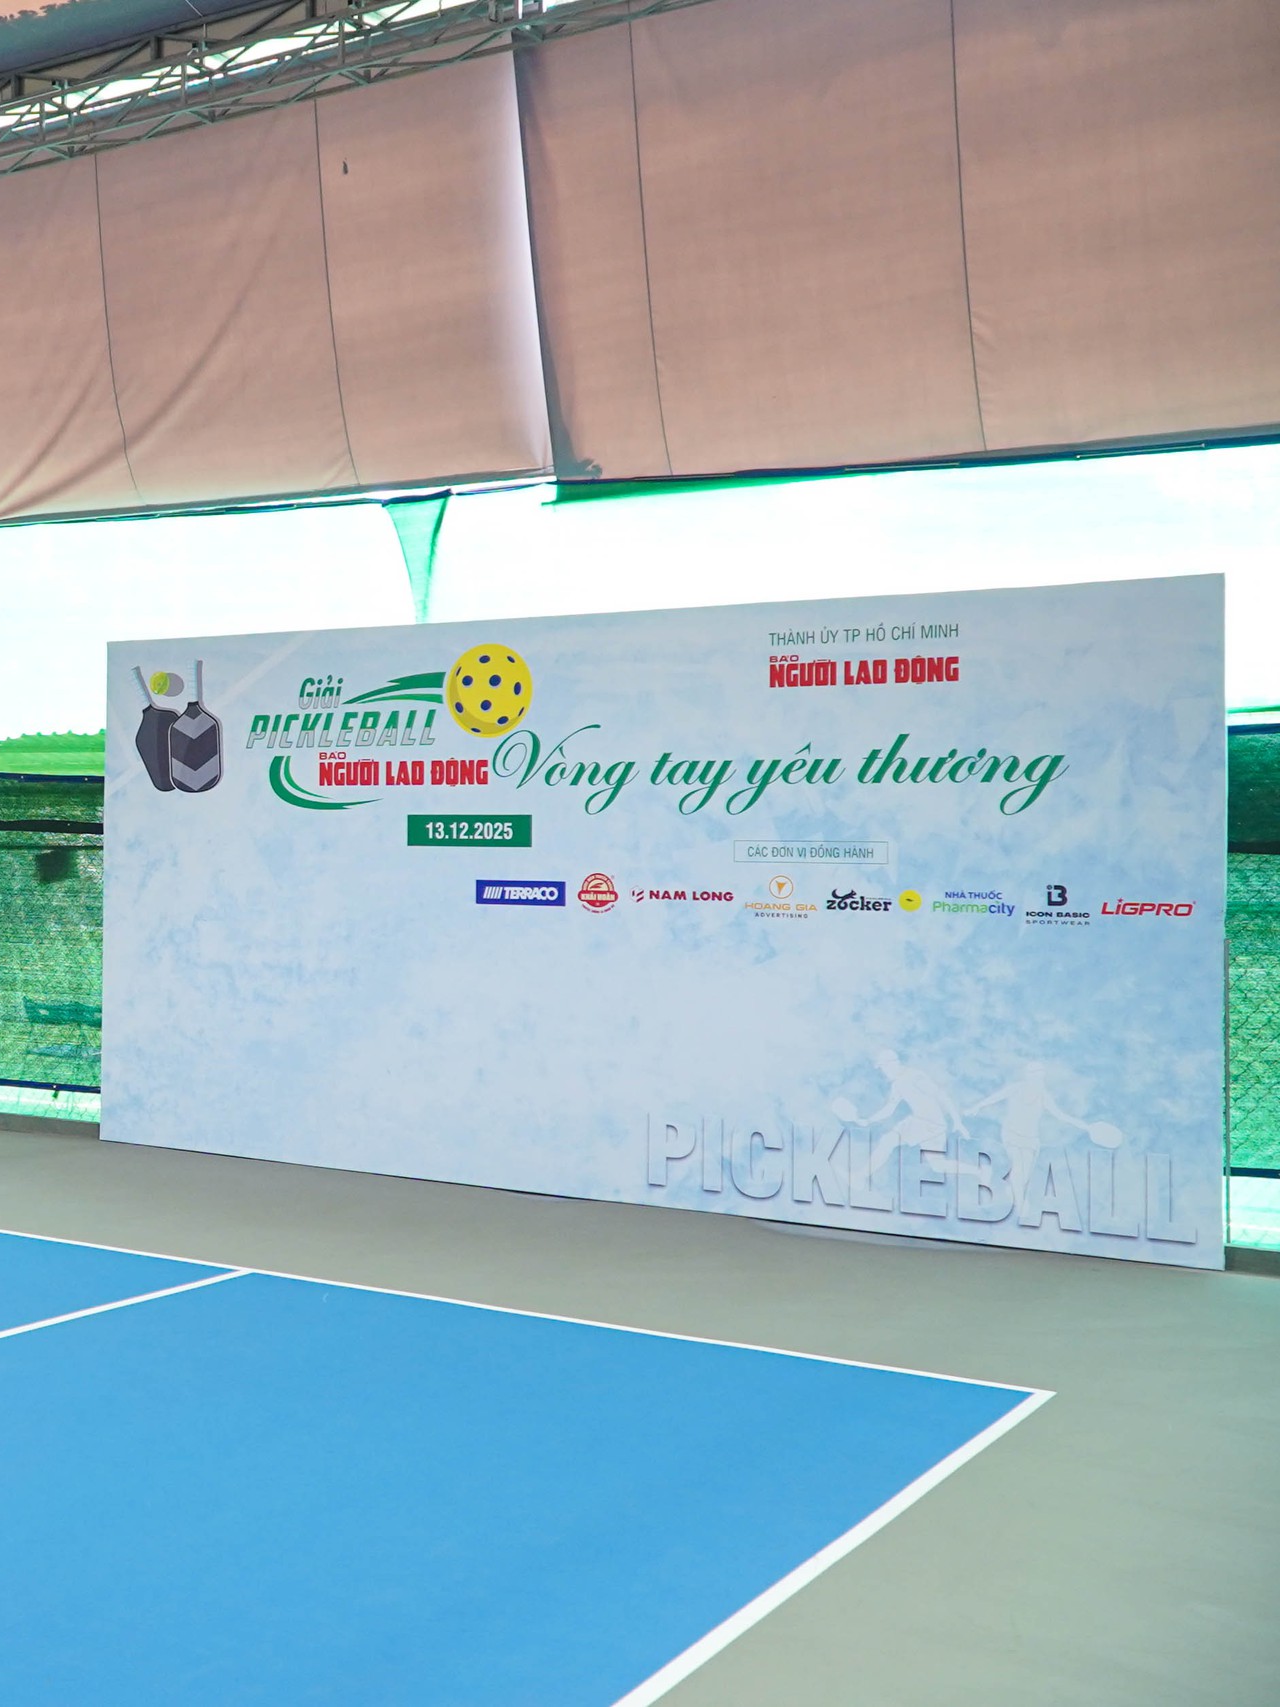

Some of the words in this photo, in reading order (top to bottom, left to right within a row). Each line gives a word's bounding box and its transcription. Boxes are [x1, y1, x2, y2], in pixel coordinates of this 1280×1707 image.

[768, 627, 816, 647] THÀNH
[820, 625, 839, 645] ỦY
[843, 628, 861, 643] TP
[866, 621, 886, 642] HỒ
[891, 622, 915, 641] CHÍ
[920, 623, 959, 640] MINH
[844, 659, 888, 686] LAO
[894, 655, 960, 685] ĐỘNG
[298, 674, 344, 710] Giải
[246, 709, 437, 749] PICKLEBALL
[385, 760, 424, 786] LAO
[430, 757, 489, 788] ĐỘNG
[492, 723, 640, 816] Vòng
[650, 752, 738, 816] tay
[726, 741, 846, 816] yêu
[857, 733, 1070, 816] thương
[425, 821, 514, 840] 13.12.2025
[747, 845, 769, 858] CÁC
[771, 846, 794, 858] ĐƠN
[797, 847, 807, 860] VỊ
[810, 845, 840, 859] ĐỒNG
[844, 846, 874, 859] HÀNH
[504, 886, 559, 901] TERRACO
[649, 890, 687, 901] NAM
[692, 890, 735, 902] LONG
[944, 890, 967, 900] NHÀ
[968, 890, 1003, 900] THUỐC
[796, 903, 818, 911] GIA
[932, 900, 1016, 917] Pharmacity
[647, 1111, 1198, 1244] PICKLEBALL
